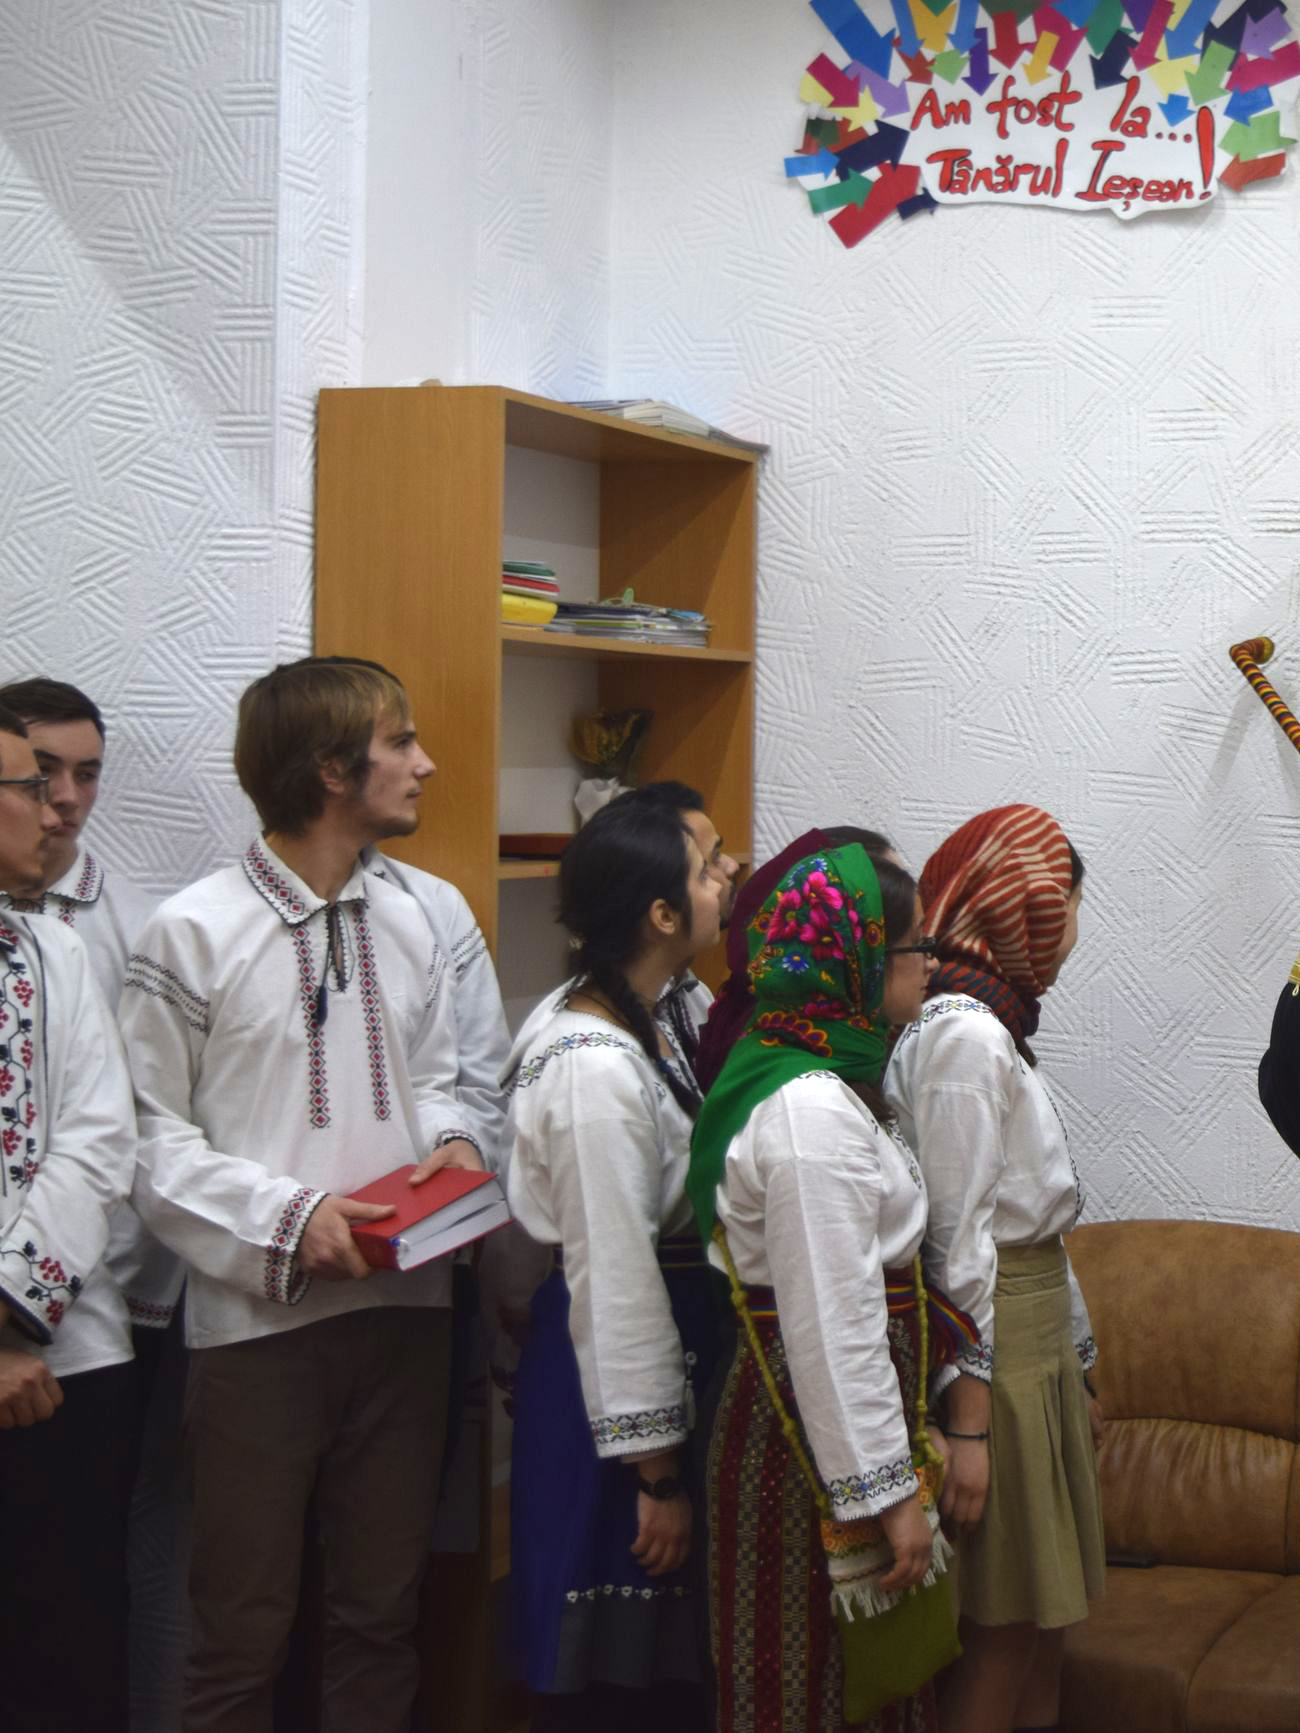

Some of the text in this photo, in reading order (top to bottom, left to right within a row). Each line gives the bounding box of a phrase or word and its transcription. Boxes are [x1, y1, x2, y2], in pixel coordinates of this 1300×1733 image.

[909, 88, 971, 131] Am
[986, 70, 1083, 140] fost
[926, 137, 1070, 199] Tânărul
